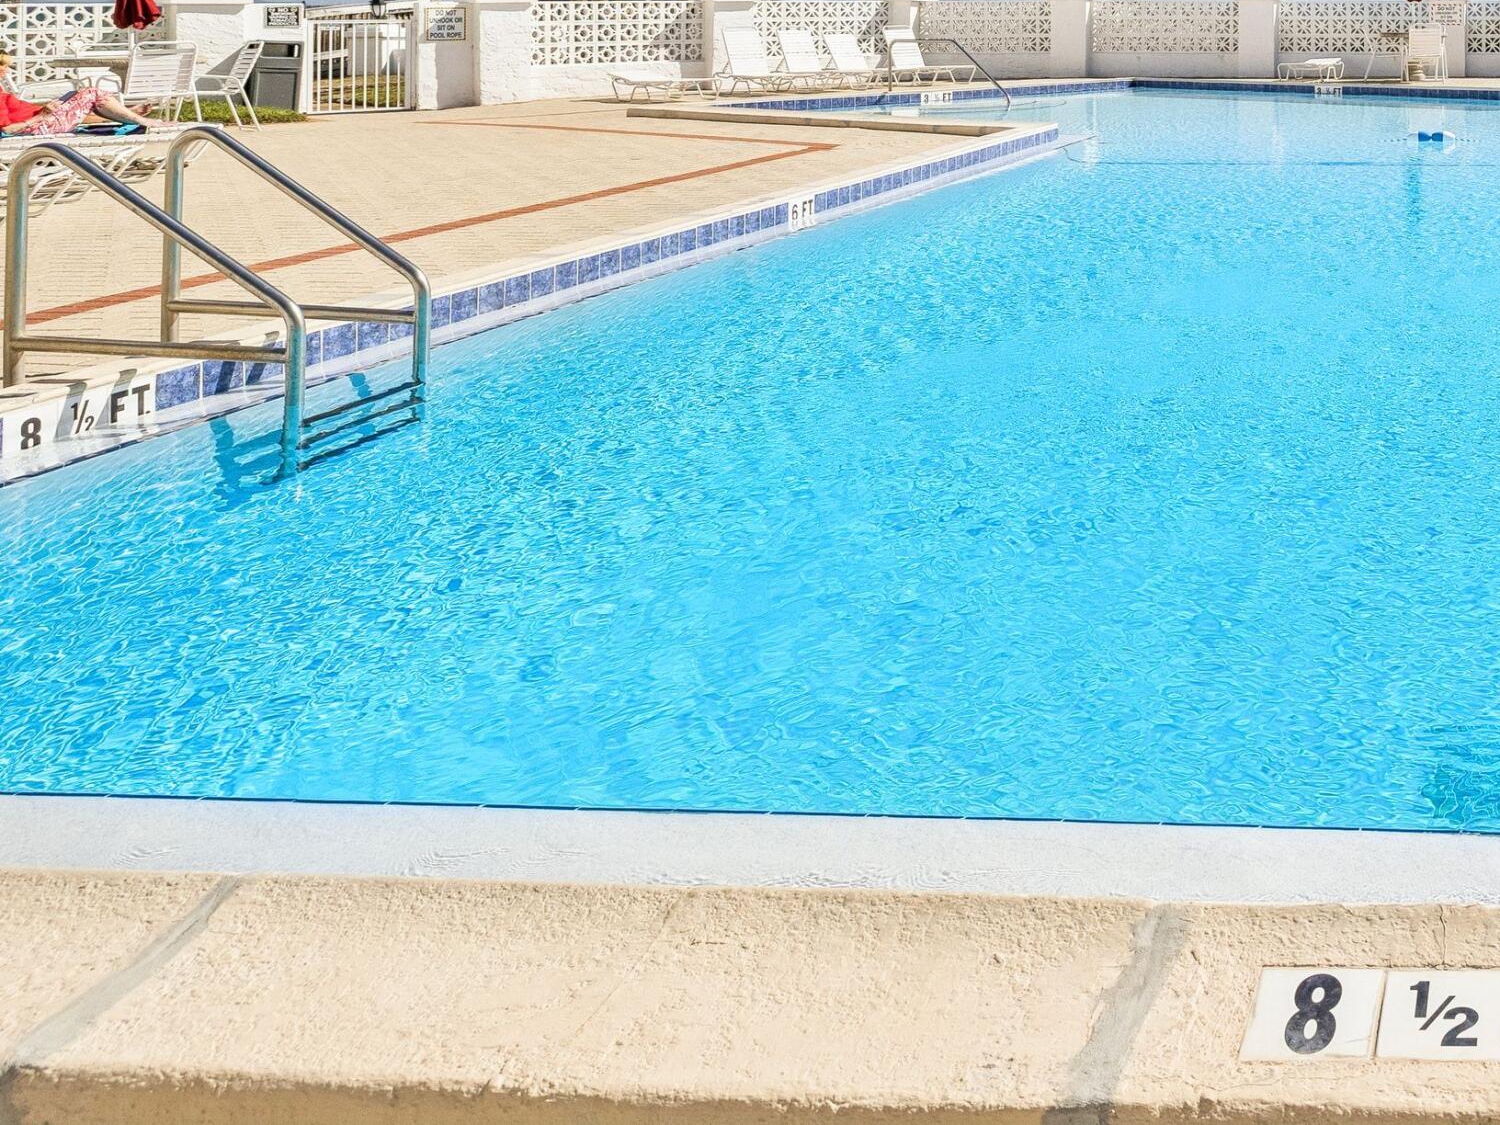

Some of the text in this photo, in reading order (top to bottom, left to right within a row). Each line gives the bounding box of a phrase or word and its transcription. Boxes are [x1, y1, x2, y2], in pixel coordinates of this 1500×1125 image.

[792, 199, 813, 220] 6 FT
[20, 417, 41, 450] 8
[1284, 973, 1342, 1055] 8
